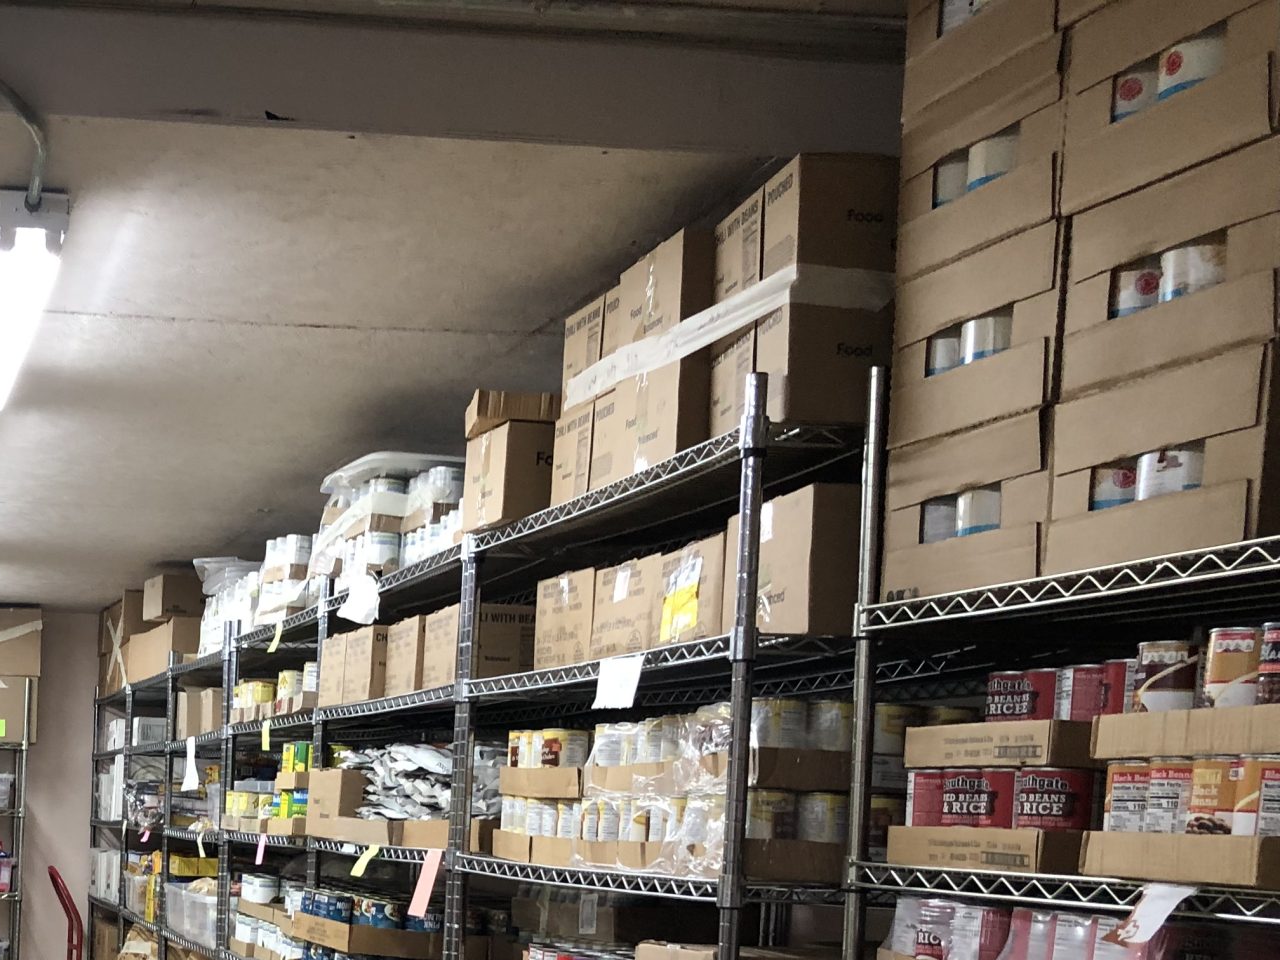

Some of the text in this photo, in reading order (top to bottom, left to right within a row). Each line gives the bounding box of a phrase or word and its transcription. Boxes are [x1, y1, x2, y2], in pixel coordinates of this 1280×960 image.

[847, 208, 885, 223] Food
[836, 343, 873, 358] Food
[535, 451, 554, 466] Fo
[491, 613, 516, 624] WITH
[518, 612, 537, 624] BEA
[1028, 793, 1066, 803] BEANS
[1166, 800, 1179, 808] 110
[952, 801, 987, 814] RICE
[1023, 801, 1063, 815] RICE
[917, 931, 940, 945] RIC
